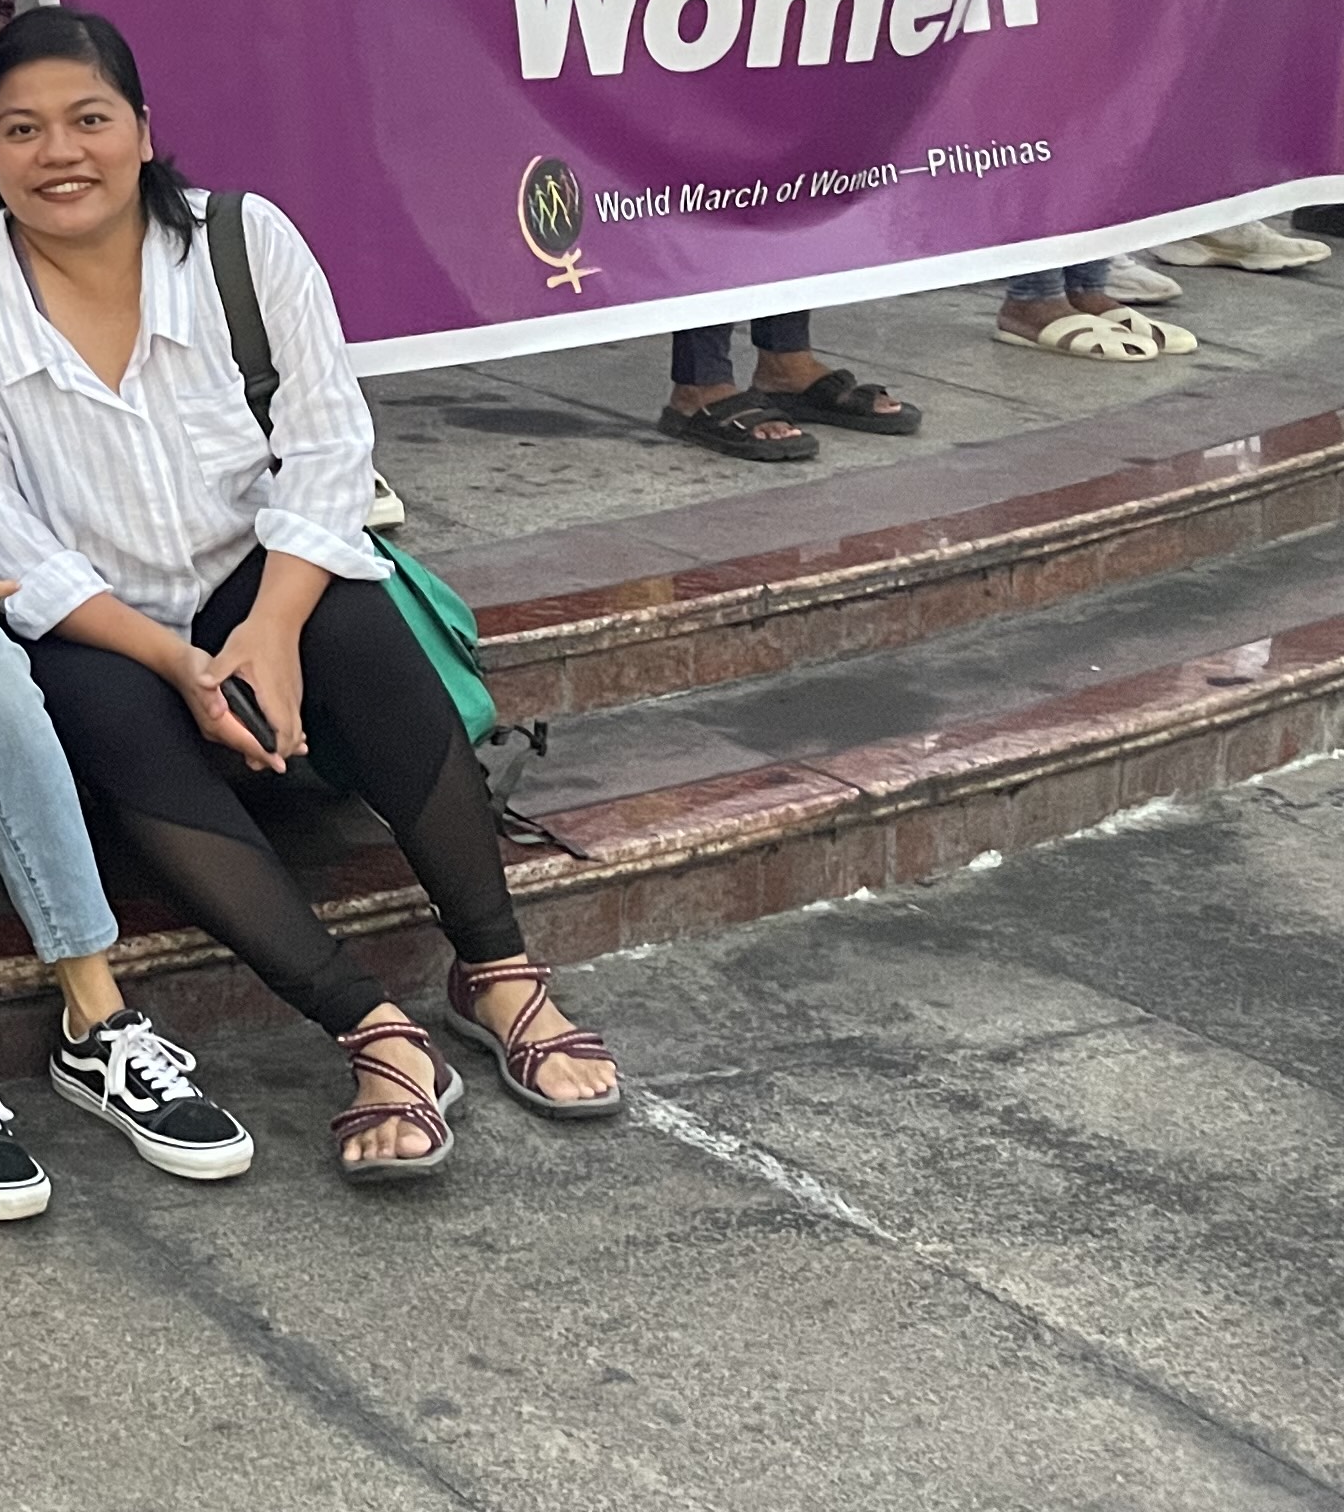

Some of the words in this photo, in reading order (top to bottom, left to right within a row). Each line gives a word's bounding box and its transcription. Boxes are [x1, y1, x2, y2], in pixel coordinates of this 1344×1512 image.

[594, 185, 670, 223] World
[679, 178, 768, 213] March
[775, 172, 803, 204] of
